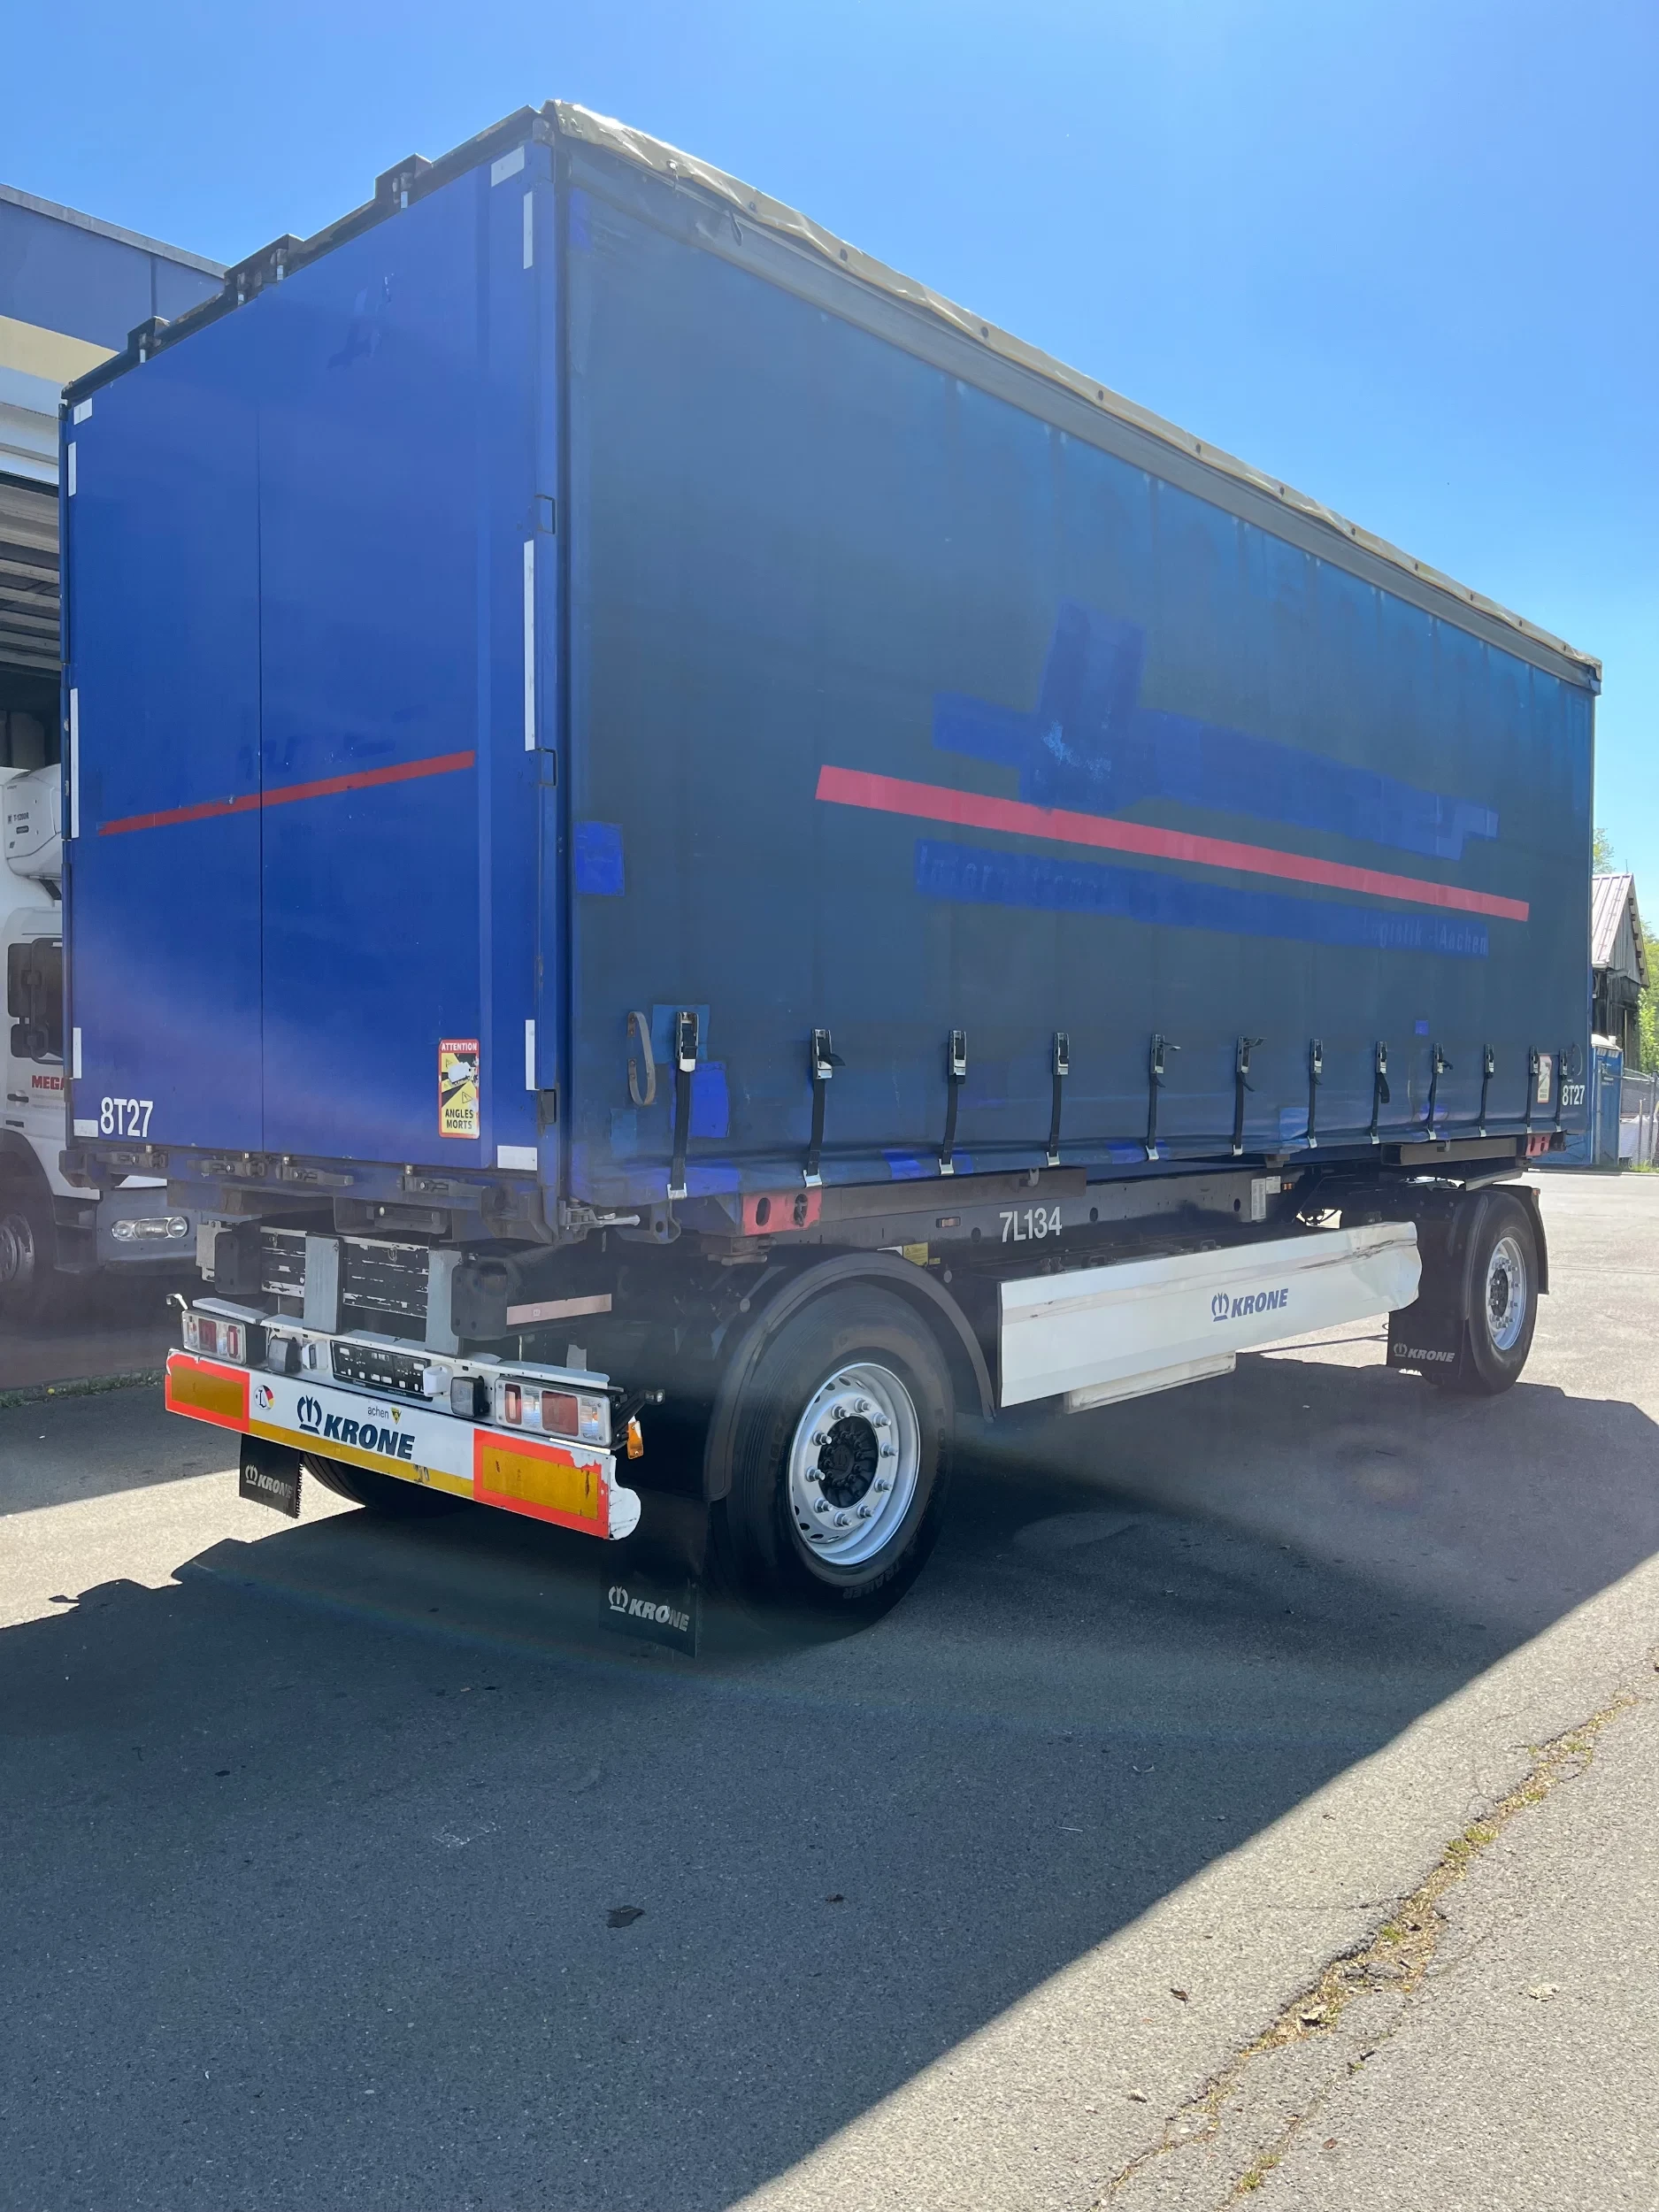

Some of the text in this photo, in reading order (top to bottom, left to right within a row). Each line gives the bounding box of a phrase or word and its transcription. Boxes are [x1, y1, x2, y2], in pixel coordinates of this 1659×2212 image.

[442, 1042, 477, 1051] ATTENTION
[1562, 1085, 1586, 1106] 8T27
[100, 1096, 154, 1138] 8T27
[445, 1109, 473, 1119] ANGLES
[447, 1119, 472, 1129] MORTS
[999, 1206, 1063, 1243] 7L134
[1231, 1288, 1288, 1318] KRONE
[1407, 1348, 1455, 1363] KRONE
[367, 1405, 389, 1419] achen
[323, 1413, 416, 1461] KRONE
[257, 1474, 293, 1499] KRONE
[628, 1598, 690, 1632] KRONE
